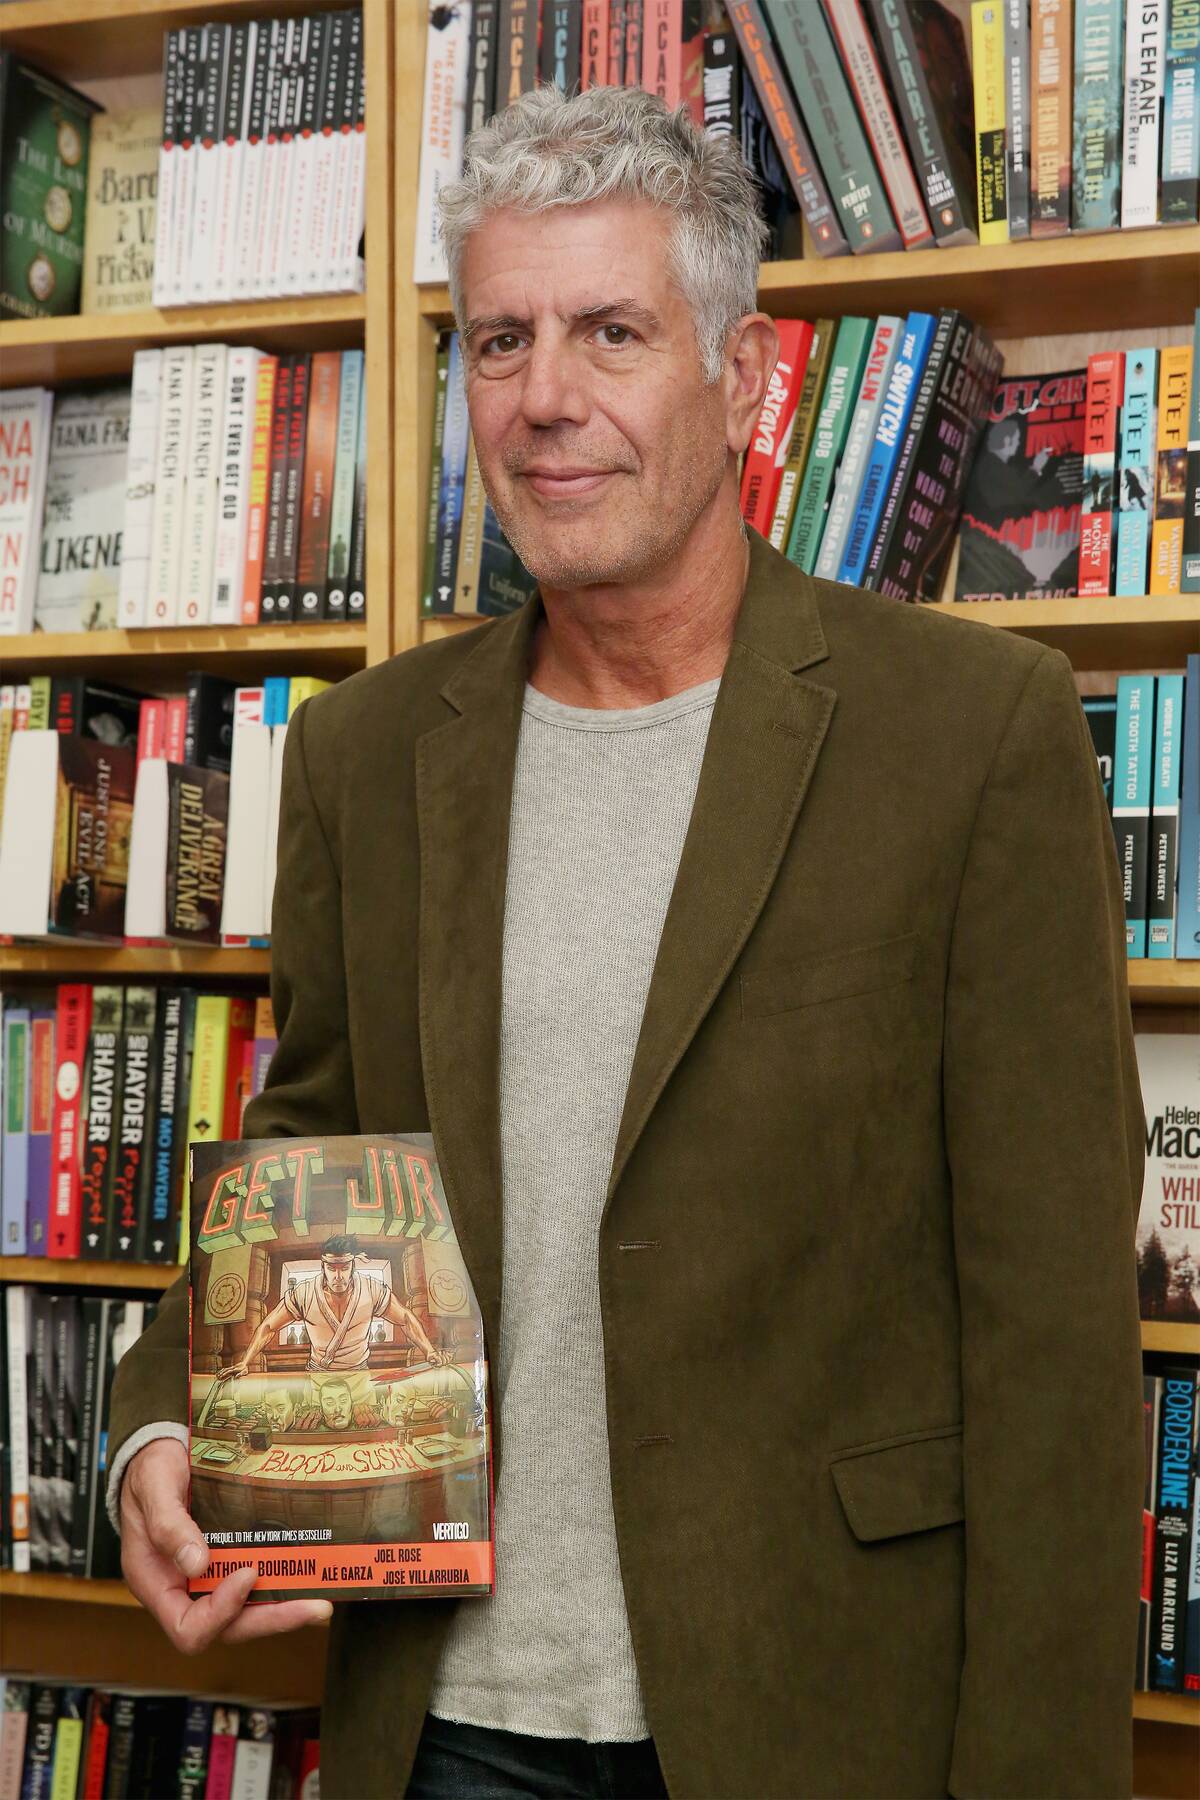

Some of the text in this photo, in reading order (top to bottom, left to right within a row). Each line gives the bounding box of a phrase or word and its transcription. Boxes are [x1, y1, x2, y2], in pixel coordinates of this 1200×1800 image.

[1038, 48, 1060, 85] HAND
[1083, 15, 1111, 85] LEHANE
[1138, 31, 1158, 126] LEHANE
[1011, 56, 1025, 174] DENNIS LEHANE
[1127, 79, 1140, 168] Mystic River
[1169, 67, 1196, 175] DENNIS LEHANE
[993, 158, 1006, 200] Tailor
[1038, 150, 1060, 201] LEHANE
[927, 315, 953, 369] ELMORE
[161, 355, 185, 479] TANA FRENCH
[193, 355, 216, 479] TANA FRENCH
[909, 370, 937, 432] LEONARD
[1090, 379, 1110, 448] LIEF
[1126, 392, 1147, 463] LIEF
[1165, 372, 1186, 442] LIEF
[225, 423, 242, 458] EVER
[802, 364, 850, 514] MAXIMUM BOB ELMORE
[845, 333, 917, 569] THE SWITCH ELMORE LEONARD
[222, 494, 238, 521] OLD
[224, 463, 240, 488] GET
[775, 470, 797, 519] ELMORE
[1081, 527, 1093, 558] KILL
[1089, 517, 1103, 567] MONEY
[1101, 531, 1112, 552] THE
[1157, 539, 1170, 576] GIRLS
[1168, 525, 1182, 590] VANISHING
[1125, 687, 1142, 801] THE TOOTH TATTOO
[1160, 697, 1175, 788] WOBBLE TO DEATH
[93, 757, 112, 869] JUST ONE
[75, 810, 94, 915] EVIL ACT
[174, 781, 204, 930] DELIVERANCE
[199, 812, 225, 903] A GREAT
[1122, 833, 1135, 903] PETER LOVESEY
[1156, 832, 1169, 902] PETER LOVESEY
[89, 1048, 116, 1142] HAYDER
[121, 1051, 148, 1144] HAYDER
[153, 997, 180, 1220] THE TREATMENT MO HAYDER
[199, 1145, 324, 1237] GET
[260, 1449, 336, 1475] BLOOD
[353, 1447, 416, 1474] SUSHI
[1161, 1378, 1194, 1510] BORDERLINE
[210, 1532, 235, 1544] PREQUEL
[235, 1532, 242, 1542] TO
[242, 1531, 254, 1542] THE
[254, 1531, 266, 1542] NEW
[266, 1530, 281, 1542] YORK
[281, 1530, 298, 1541] TIMES
[298, 1529, 332, 1541] BESTSELLER!
[374, 1547, 422, 1564] JOEL ROSE
[432, 1522, 469, 1541] VERTIGO
[1164, 1541, 1180, 1573] LIZA
[258, 1559, 317, 1578] BOURDAIN
[340, 1566, 374, 1582] GARZA
[382, 1567, 470, 1585] JOSÉ VILLARRUBIA
[1160, 1577, 1178, 1652] MARKLUND
